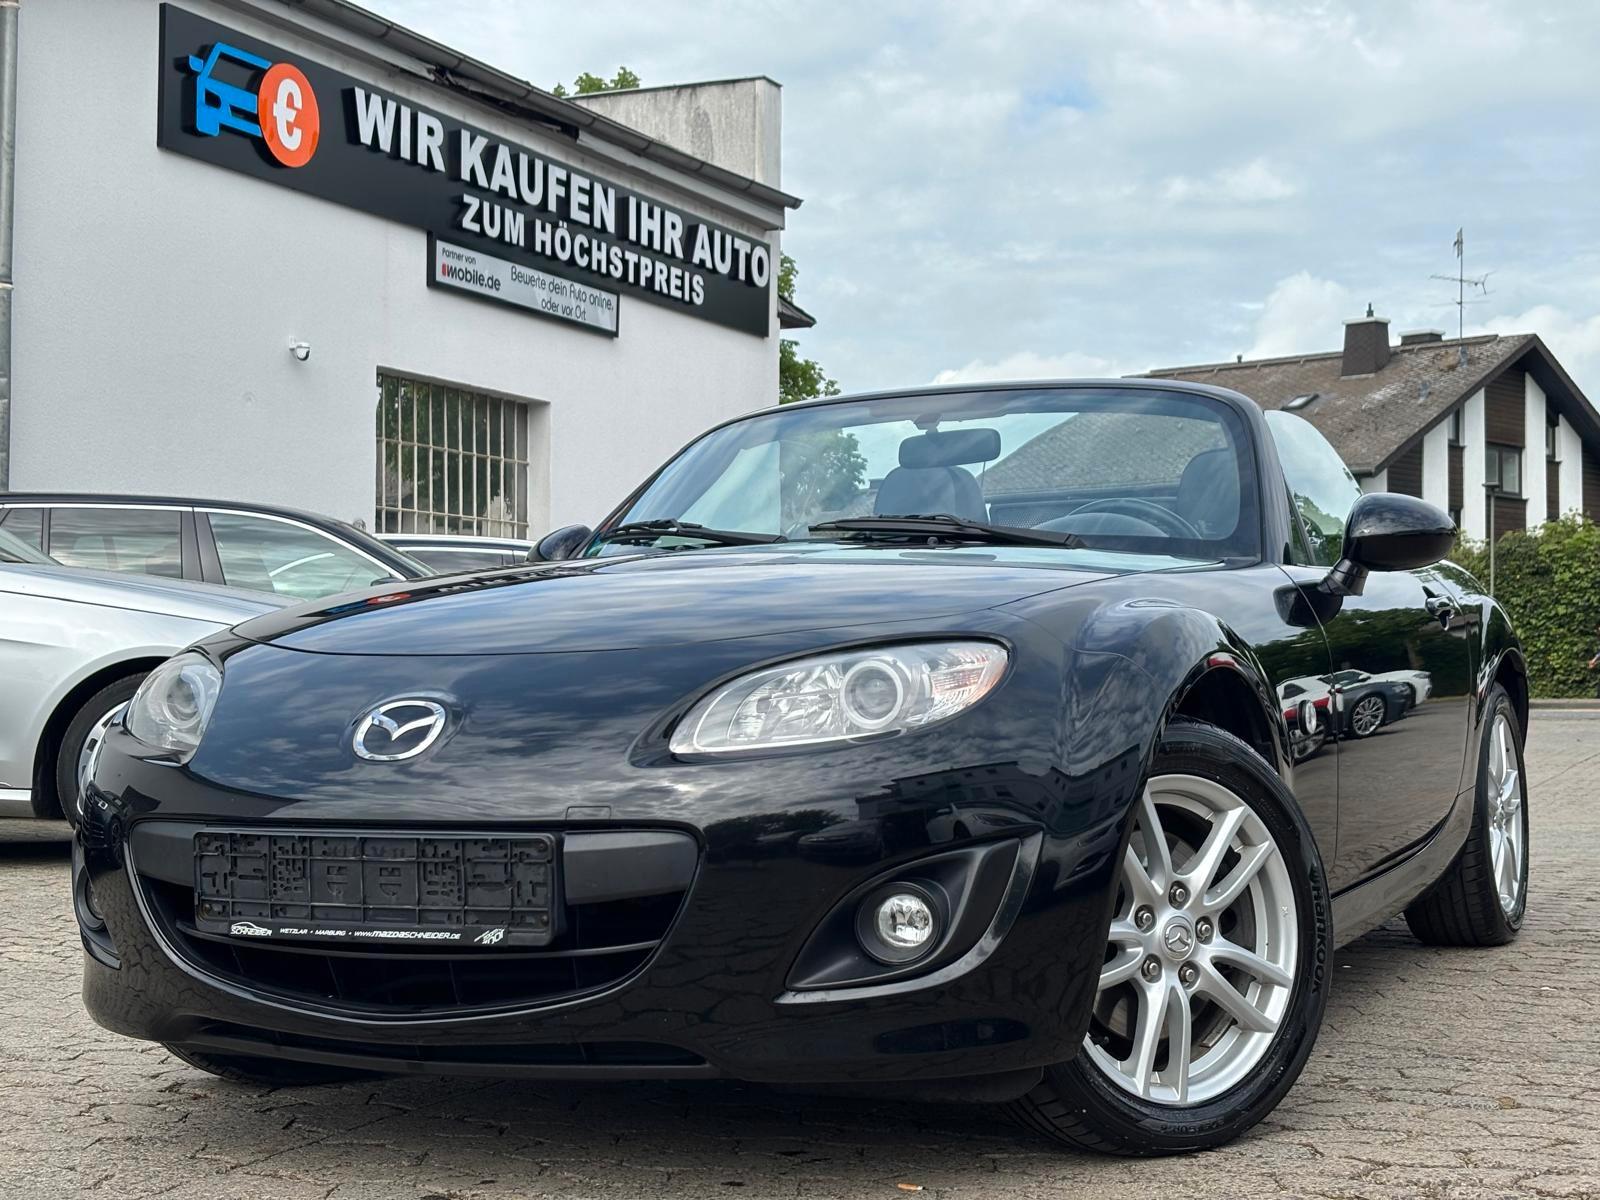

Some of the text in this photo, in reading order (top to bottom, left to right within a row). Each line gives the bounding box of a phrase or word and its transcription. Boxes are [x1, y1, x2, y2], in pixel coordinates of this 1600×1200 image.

[273, 79, 304, 150] €
[354, 87, 770, 288] WIR KAUFEN IHR AUTO
[442, 248, 477, 265] Partner von
[462, 194, 705, 306] ZUM HÖCHSTPREIS
[446, 265, 501, 292] mobile.de
[511, 265, 546, 290] Bewerte
[547, 278, 568, 296] dein
[569, 286, 587, 303] Auto
[541, 298, 587, 322] oder vor Ort
